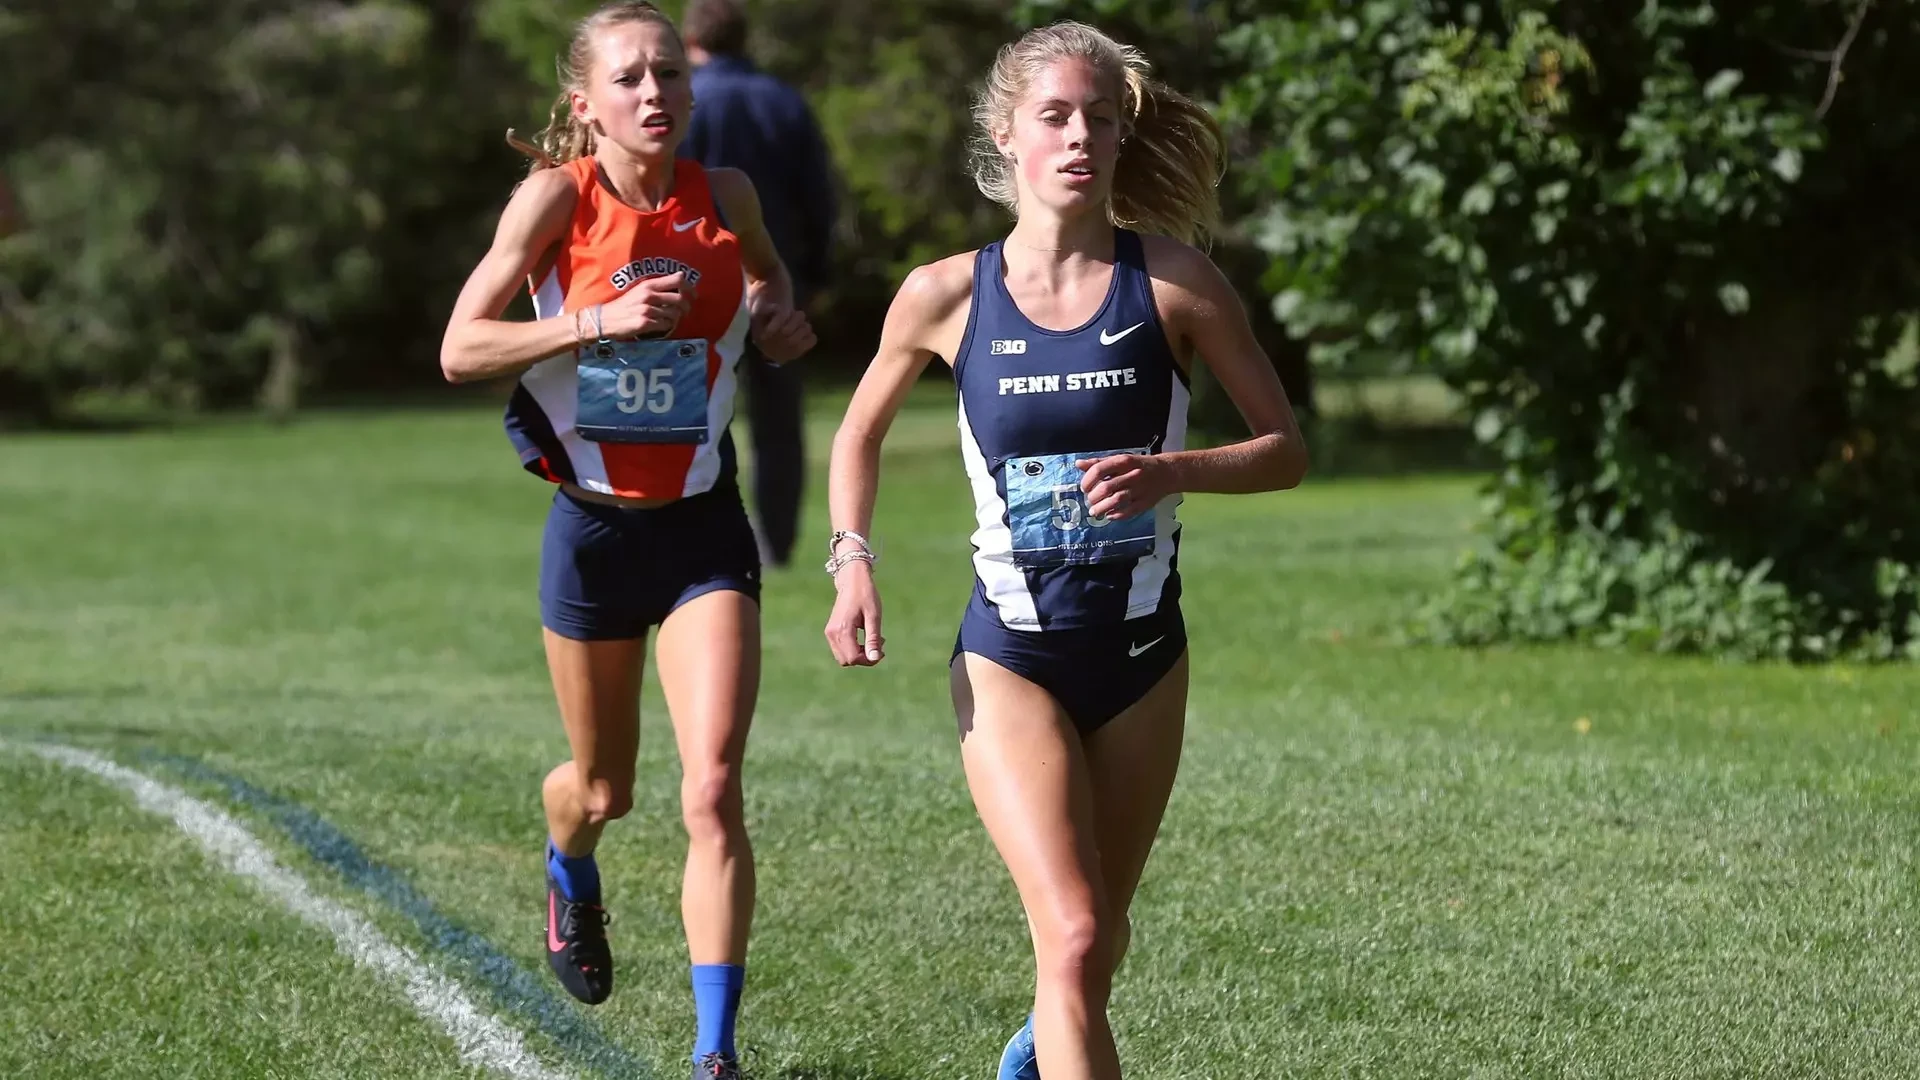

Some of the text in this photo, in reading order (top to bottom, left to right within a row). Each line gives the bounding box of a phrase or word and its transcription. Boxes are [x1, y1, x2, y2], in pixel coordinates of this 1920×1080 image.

[616, 368, 674, 414] 95
[998, 367, 1137, 396] PENN STATE
